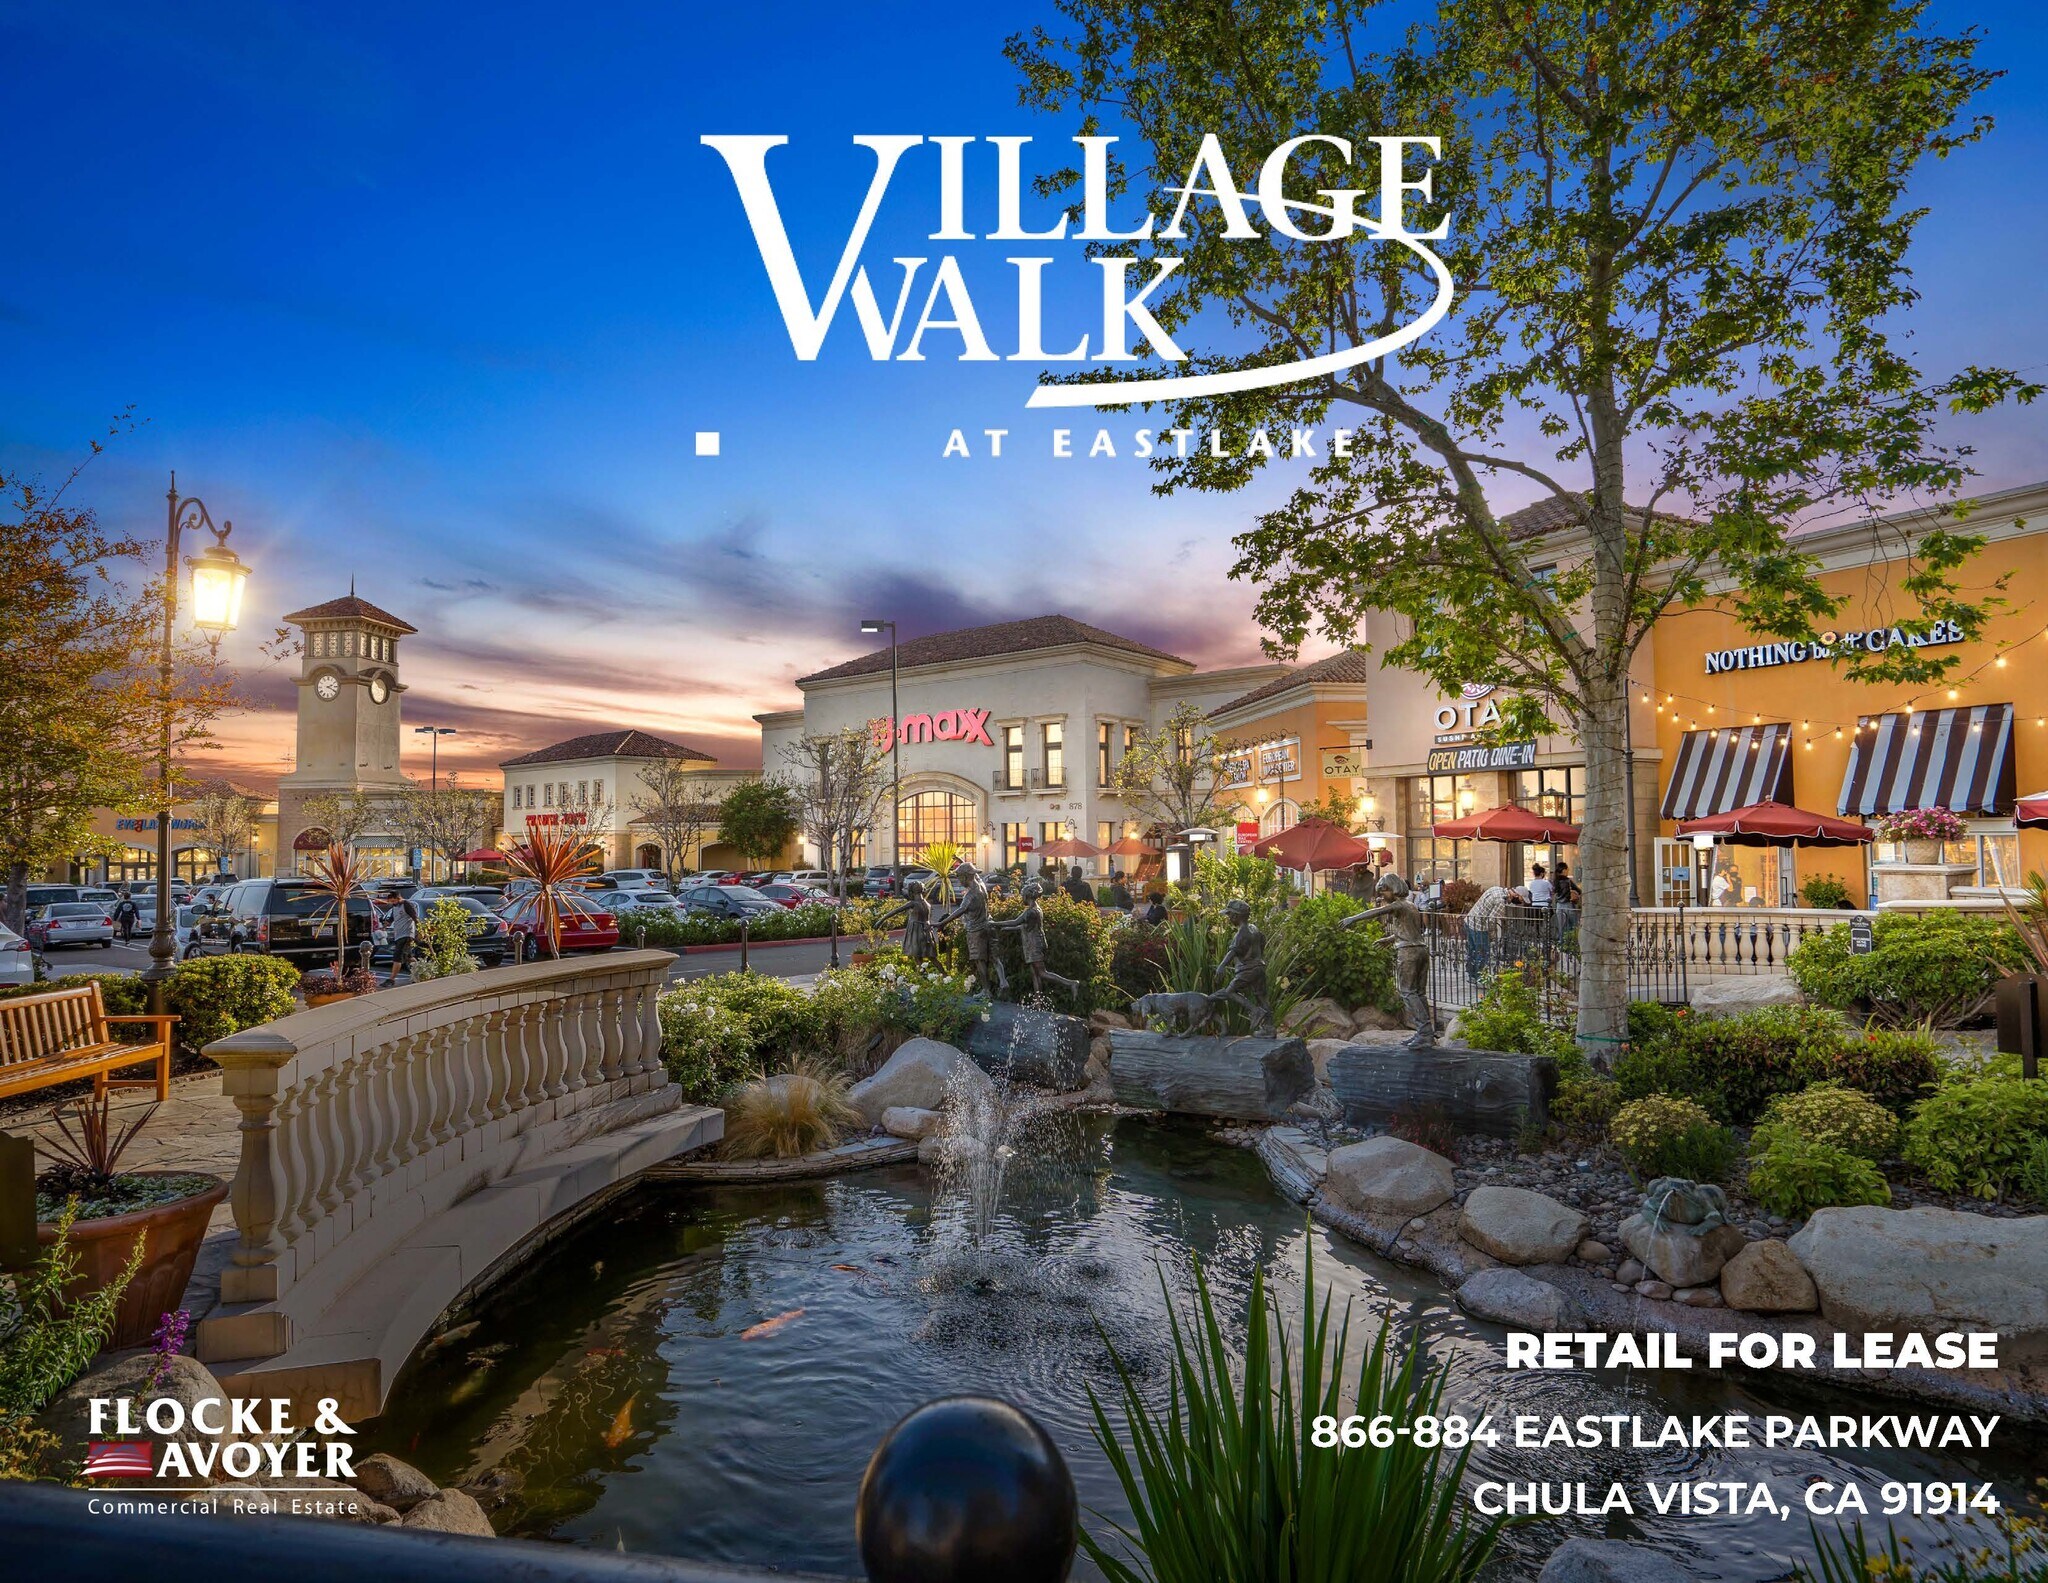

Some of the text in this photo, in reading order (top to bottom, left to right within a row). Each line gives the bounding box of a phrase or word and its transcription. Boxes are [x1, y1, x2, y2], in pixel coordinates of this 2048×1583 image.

[1704, 641, 1806, 674] NOTHING
[1434, 699, 1518, 730] OTA
[1324, 765, 1360, 775] OTAY
[1428, 744, 1536, 771] OPEN PATIO DINE-IN
[1068, 802, 1083, 810] 878
